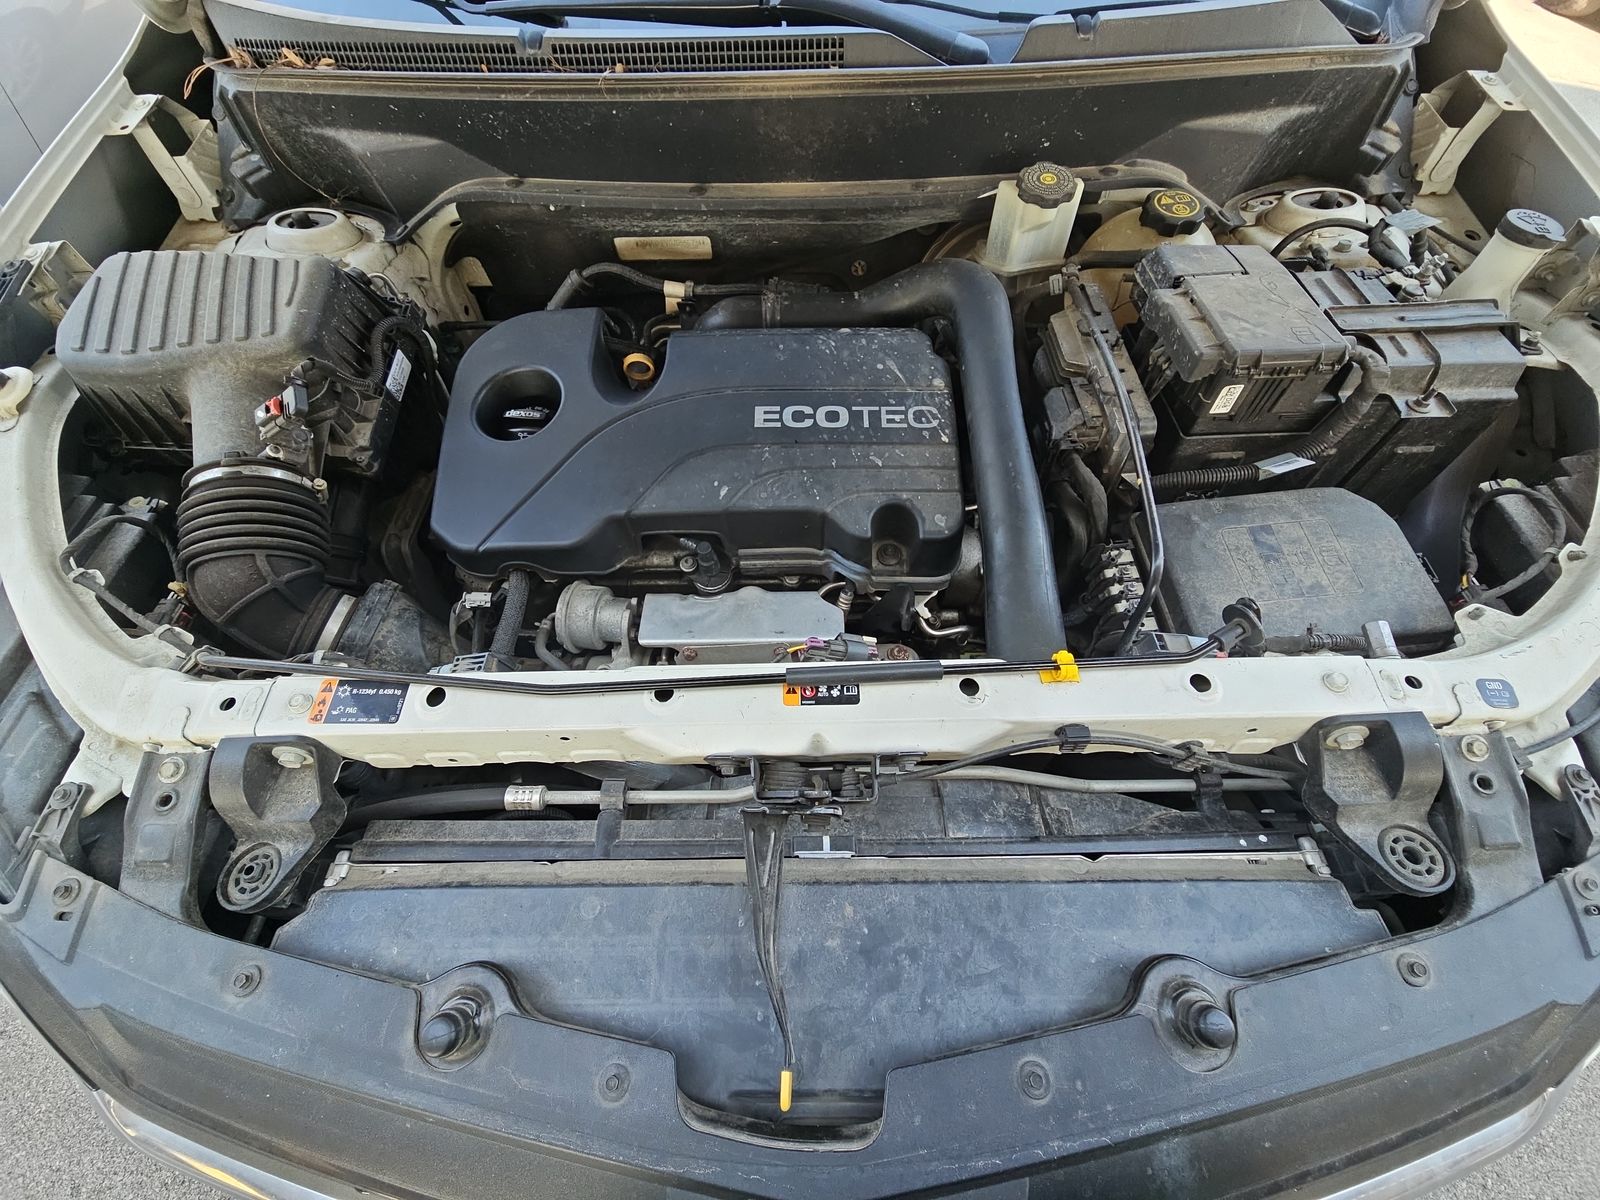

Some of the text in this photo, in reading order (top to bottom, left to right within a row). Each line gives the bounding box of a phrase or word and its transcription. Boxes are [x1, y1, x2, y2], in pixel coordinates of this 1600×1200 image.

[505, 409, 541, 418] dexos
[754, 405, 940, 428] ECOTEC
[1485, 681, 1503, 690] GND
[393, 688, 402, 696] kg
